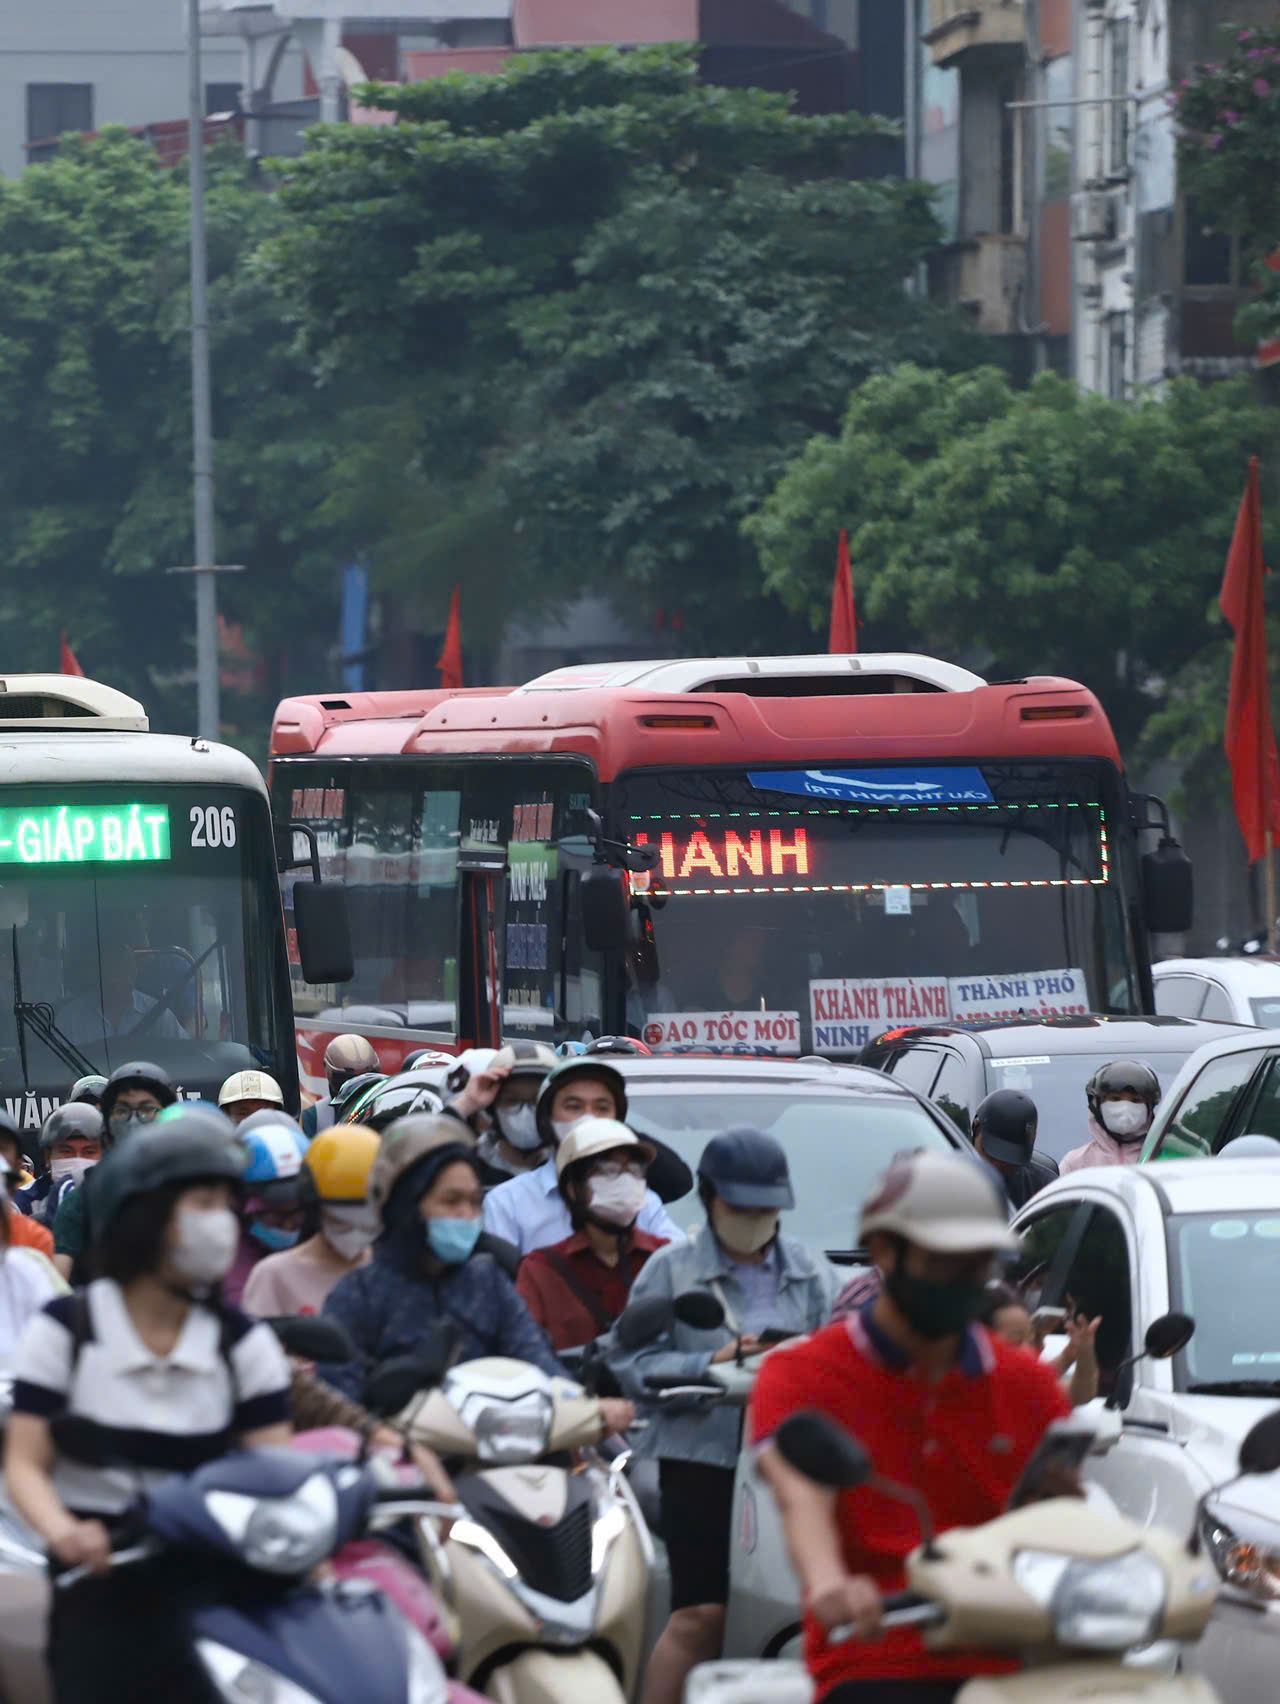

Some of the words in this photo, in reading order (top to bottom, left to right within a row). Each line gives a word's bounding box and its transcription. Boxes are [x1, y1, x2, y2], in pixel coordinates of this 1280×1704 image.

[101, 803, 167, 861] BÁT
[189, 806, 236, 848] 206
[883, 978, 947, 1019] THÀNH
[958, 977, 1030, 1002] THÀNH
[658, 1020, 698, 1042] AO
[704, 1011, 748, 1041] TỐC
[815, 1026, 869, 1047] NINH
